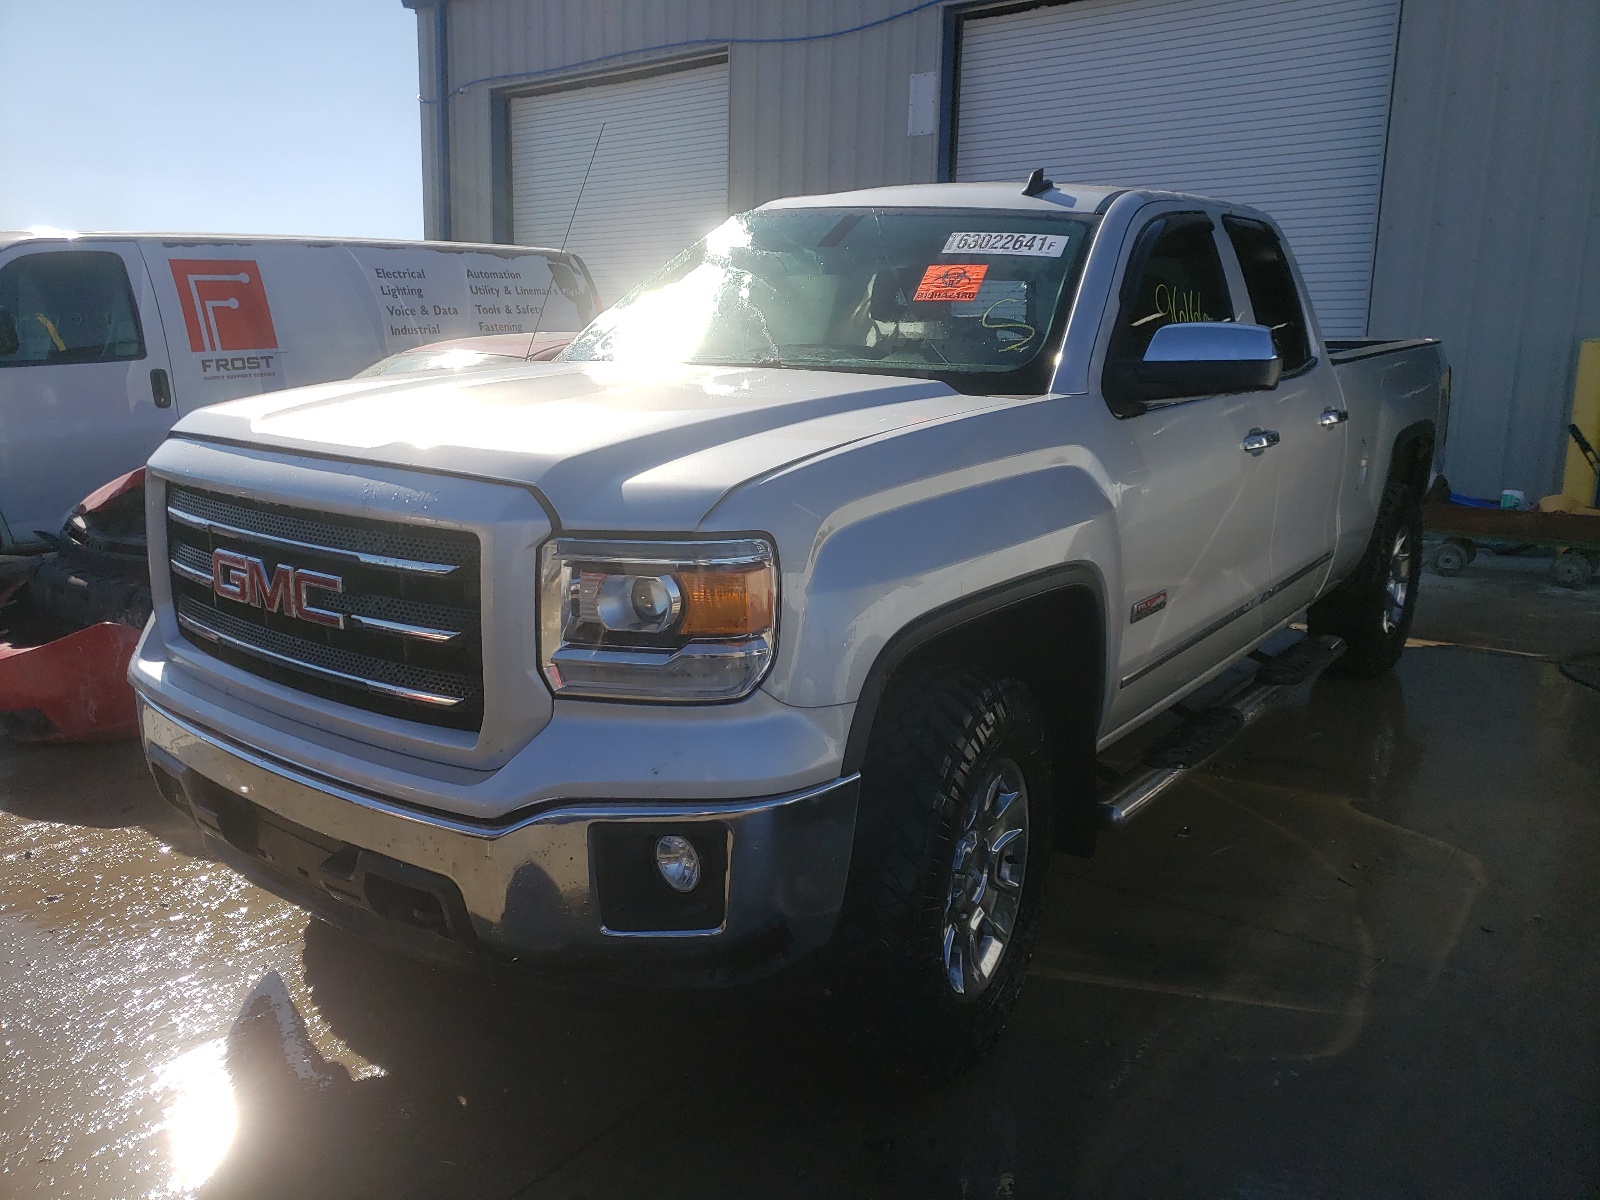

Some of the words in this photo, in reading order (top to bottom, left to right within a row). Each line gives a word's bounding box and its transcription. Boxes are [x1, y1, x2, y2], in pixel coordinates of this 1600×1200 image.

[956, 233, 1048, 252] 63022641
[1046, 241, 1057, 251] F
[375, 268, 426, 279] Electrical
[466, 268, 522, 280] Automation
[380, 285, 423, 298] Lighting
[469, 285, 500, 298] Utility
[504, 286, 512, 295] &
[917, 292, 976, 300] BIOHAZARD
[386, 305, 418, 316] Voice
[421, 306, 430, 316] &
[434, 305, 459, 316] Data
[475, 304, 501, 315] Tools
[505, 304, 512, 314] &
[516, 304, 544, 317] Safety
[390, 324, 441, 336] Industrial
[479, 322, 523, 334] Fastening
[201, 355, 274, 373] FROST
[212, 547, 345, 630] GMC
